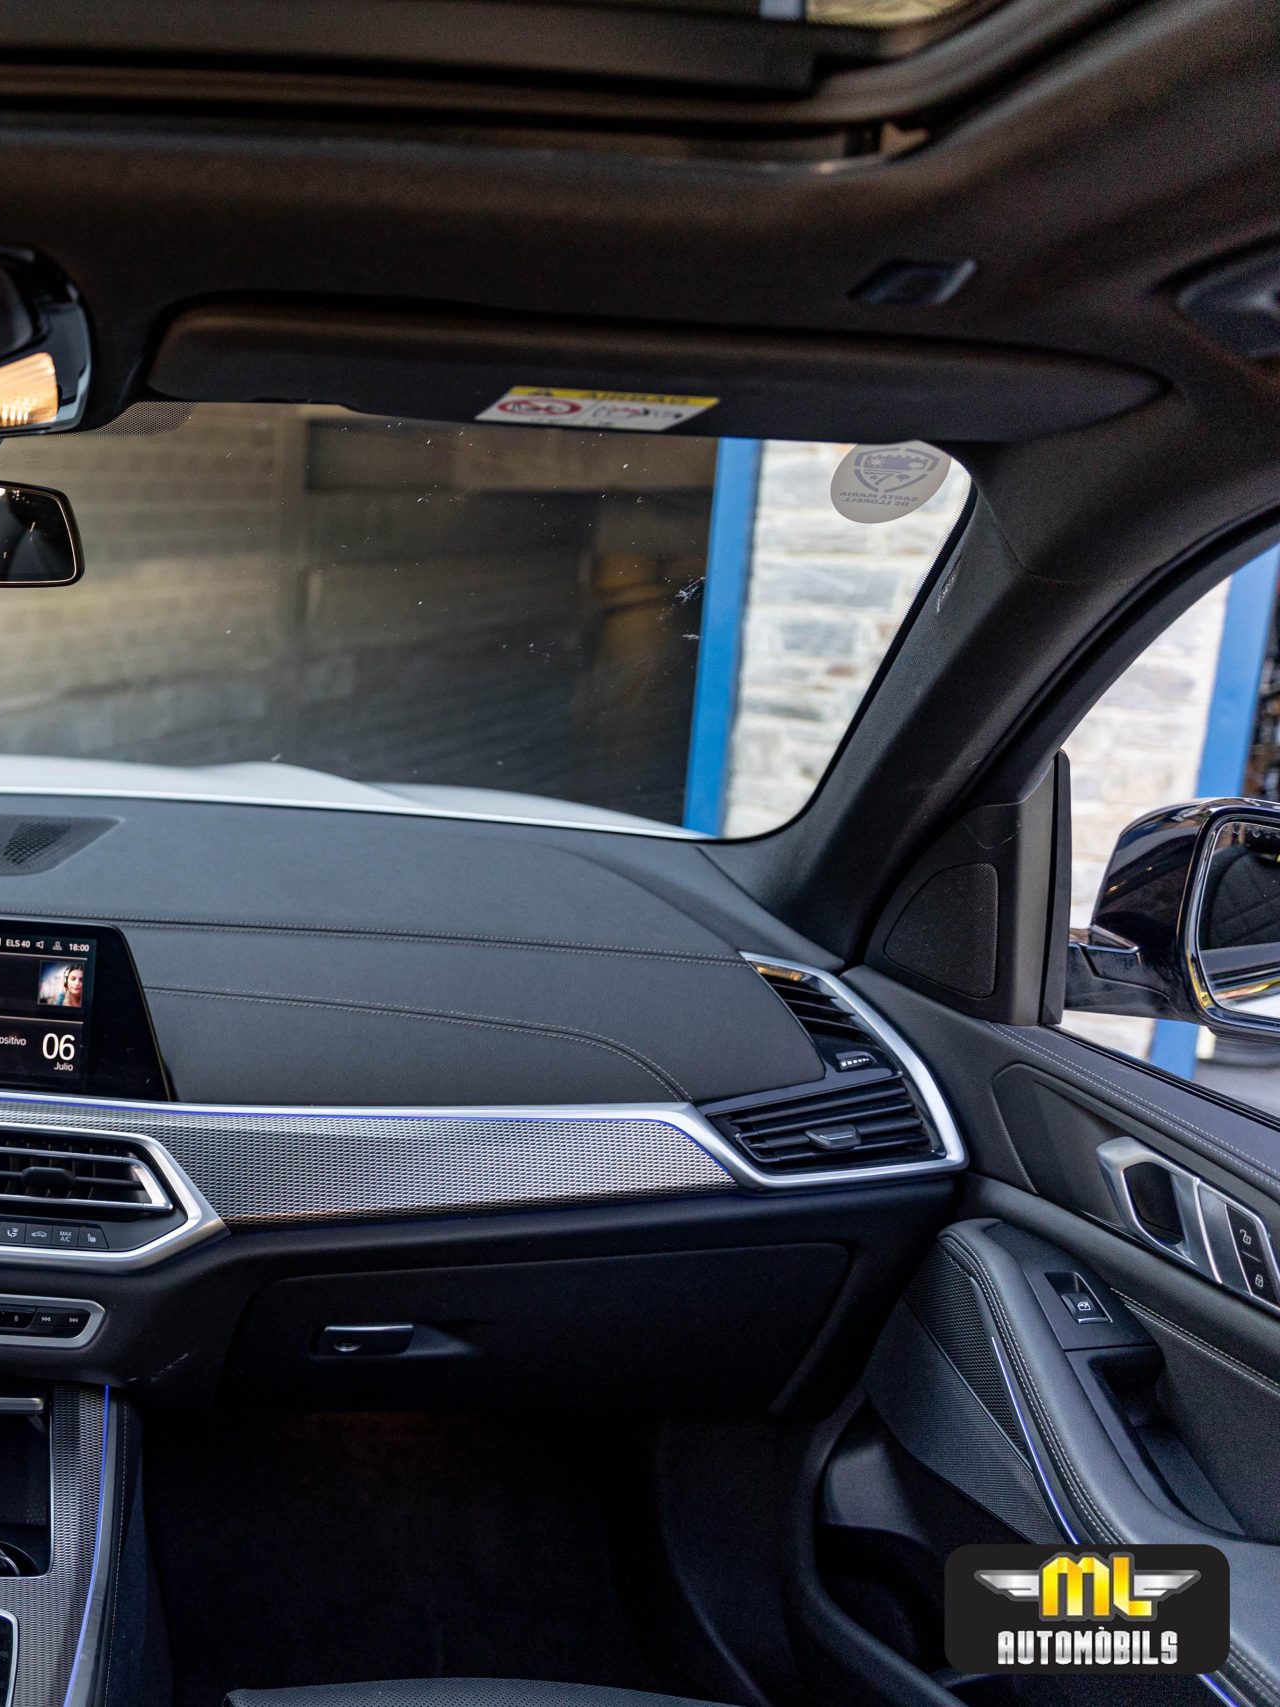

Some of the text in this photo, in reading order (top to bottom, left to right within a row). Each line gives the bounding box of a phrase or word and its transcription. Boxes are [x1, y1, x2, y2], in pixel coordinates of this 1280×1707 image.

[6, 940, 20, 948] ELS
[20, 940, 30, 948] 40
[69, 944, 90, 952] 18:00
[42, 1032, 75, 1060] 06
[54, 1062, 74, 1071] Julio
